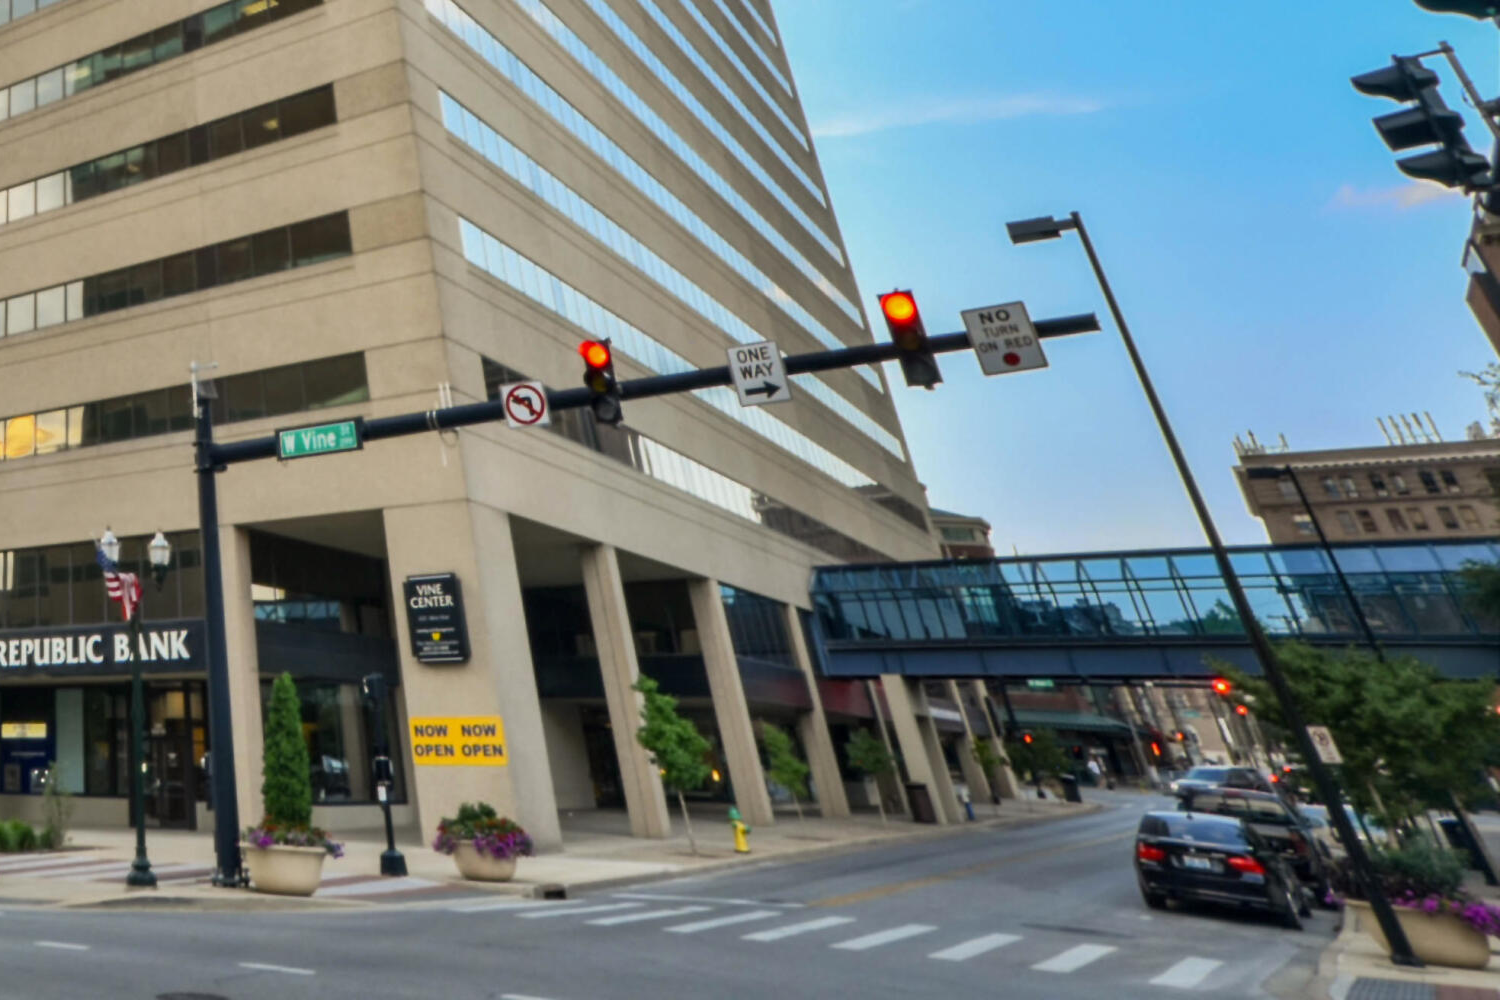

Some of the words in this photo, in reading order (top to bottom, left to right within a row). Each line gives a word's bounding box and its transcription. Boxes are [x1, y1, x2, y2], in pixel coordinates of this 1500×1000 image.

[978, 309, 1010, 325] NO
[983, 323, 1019, 338] TURN
[978, 341, 998, 353] ON
[1004, 335, 1033, 349] RED
[736, 346, 770, 364] ONE
[740, 362, 773, 380] WAY
[283, 432, 296, 453] W
[301, 430, 337, 451] Vine
[416, 583, 443, 596] VINE
[410, 595, 454, 609] CENTER
[414, 725, 448, 737] NOW
[461, 724, 496, 737] NOW
[414, 744, 455, 757] OPEN
[461, 744, 504, 757] OPEN
